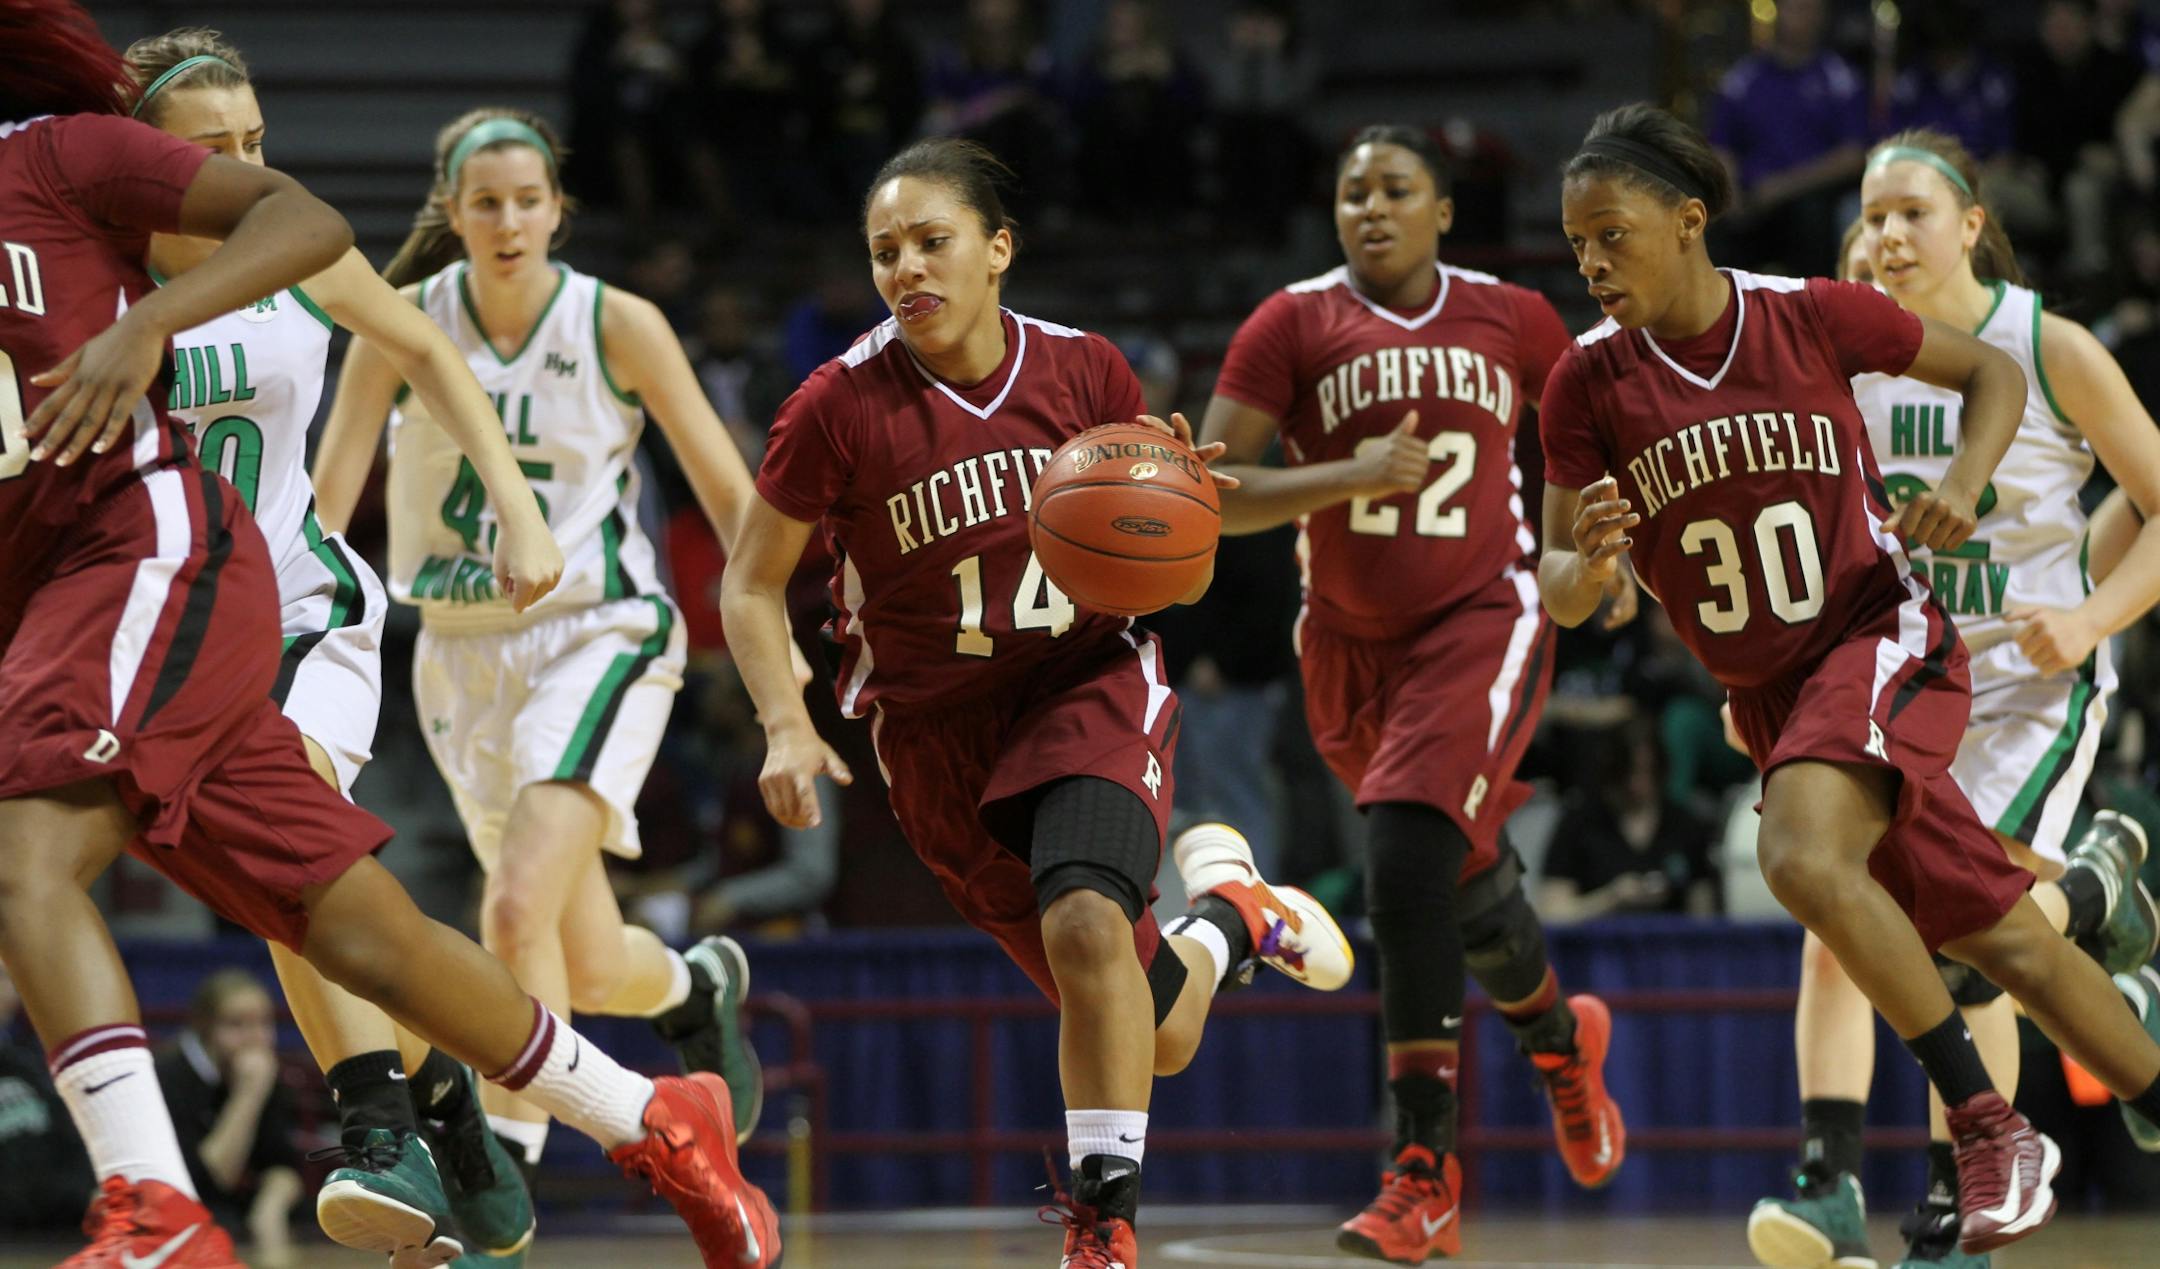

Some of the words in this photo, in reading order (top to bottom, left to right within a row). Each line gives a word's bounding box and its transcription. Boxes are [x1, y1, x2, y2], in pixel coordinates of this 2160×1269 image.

[1317, 346, 1512, 434] RICHFIELD
[1069, 443, 1203, 485] SPALDING
[1628, 411, 1841, 518] RICHFIELD
[1891, 404, 1964, 456] HIL
[1348, 431, 1478, 538] 22
[1680, 500, 1826, 634] 30
[951, 549, 1076, 658] 14
[1141, 750, 1162, 800] R
[1863, 718, 1890, 763] R
[1463, 773, 1488, 822] R
